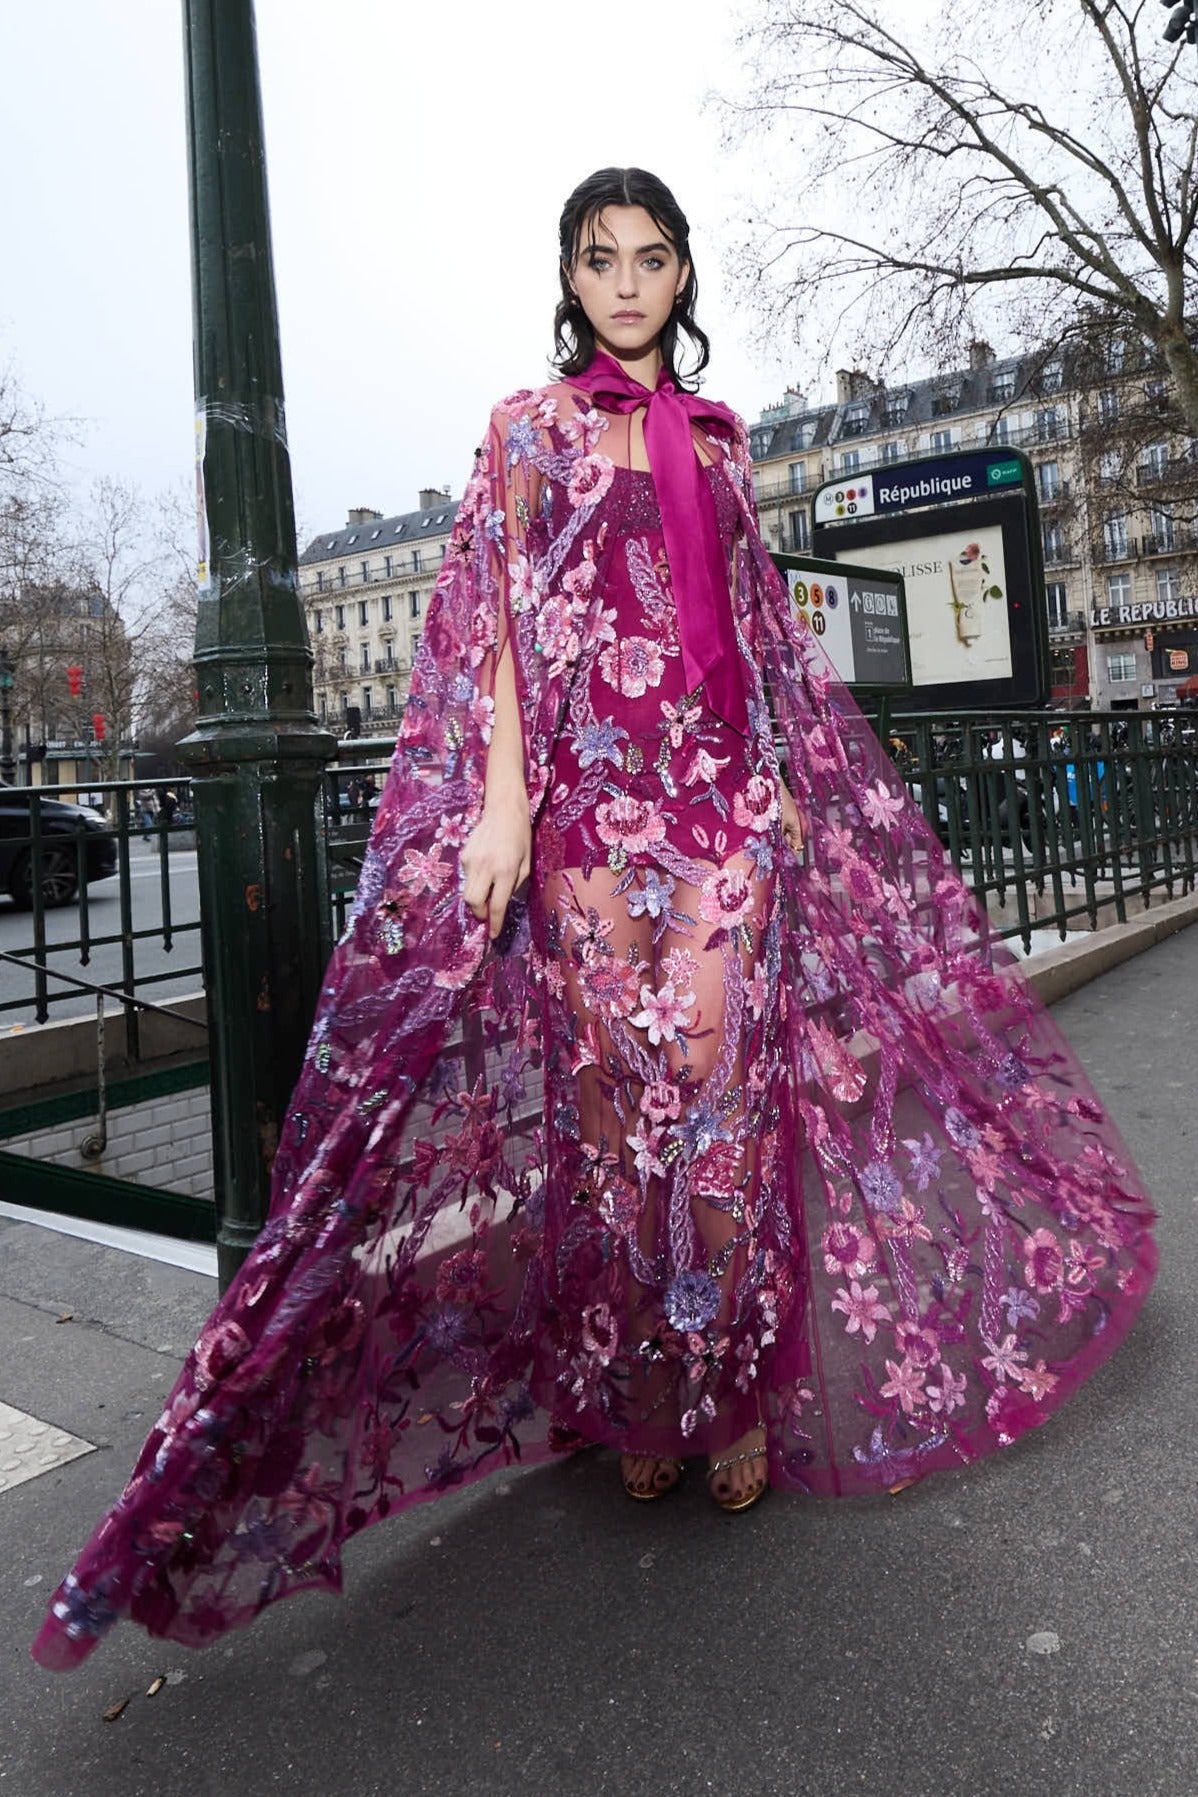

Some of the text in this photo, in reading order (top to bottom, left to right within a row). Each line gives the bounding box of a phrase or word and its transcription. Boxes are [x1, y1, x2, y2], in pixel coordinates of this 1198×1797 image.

[880, 475, 972, 505] République
[798, 587, 835, 604] 3 5 8
[813, 615, 824, 632] 11
[1090, 607, 1111, 627] LE
